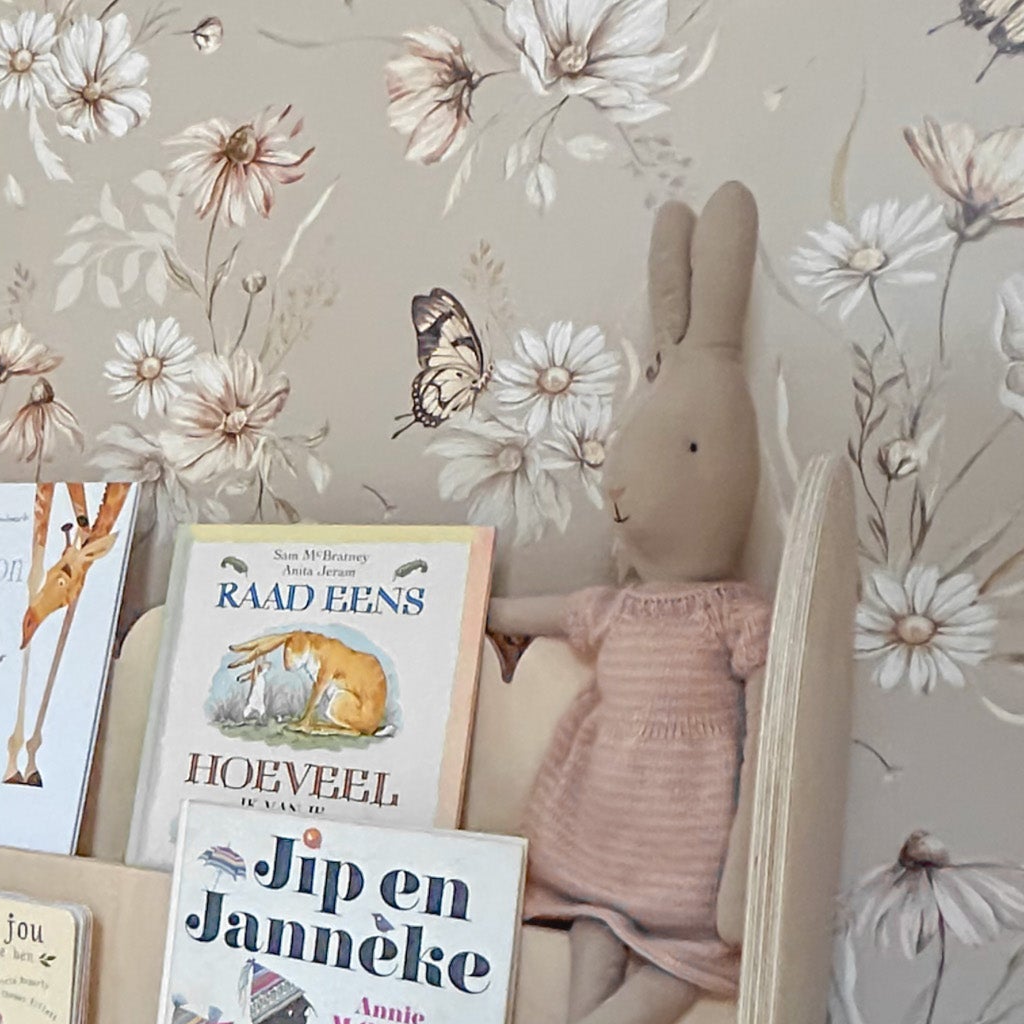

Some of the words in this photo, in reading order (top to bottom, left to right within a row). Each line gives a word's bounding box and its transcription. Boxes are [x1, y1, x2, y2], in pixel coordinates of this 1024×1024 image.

[273, 549, 298, 561] Sam
[282, 564, 313, 577] Anita
[317, 565, 356, 578] Jeram
[215, 582, 316, 612] RAAD
[321, 585, 426, 616] EENS
[184, 752, 399, 808] HOEVEEL
[254, 829, 364, 916] Jip
[379, 869, 472, 922] en
[3, 912, 44, 945] jou
[185, 889, 491, 994] Janneke
